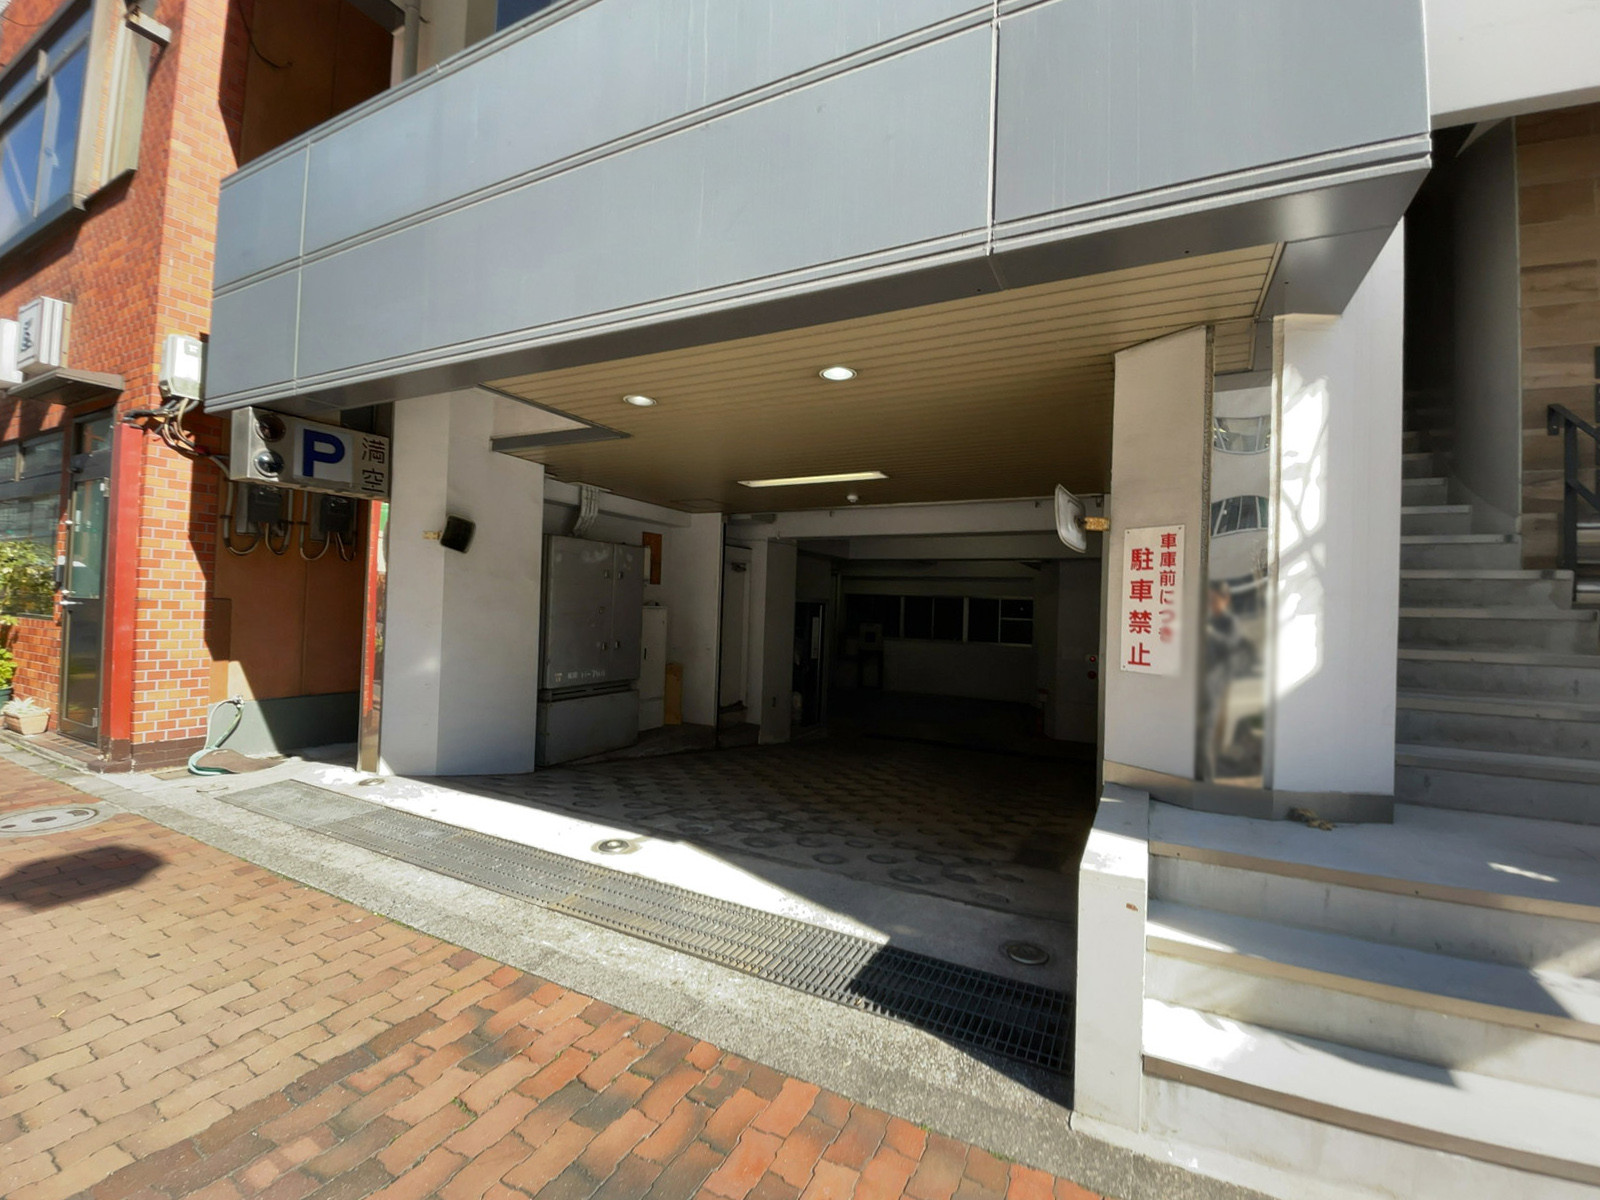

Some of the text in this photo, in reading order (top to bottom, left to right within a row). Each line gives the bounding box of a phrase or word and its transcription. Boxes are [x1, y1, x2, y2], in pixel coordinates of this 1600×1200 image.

[303, 429, 345, 477] P
[1128, 548, 1154, 667] 駐車禁止
